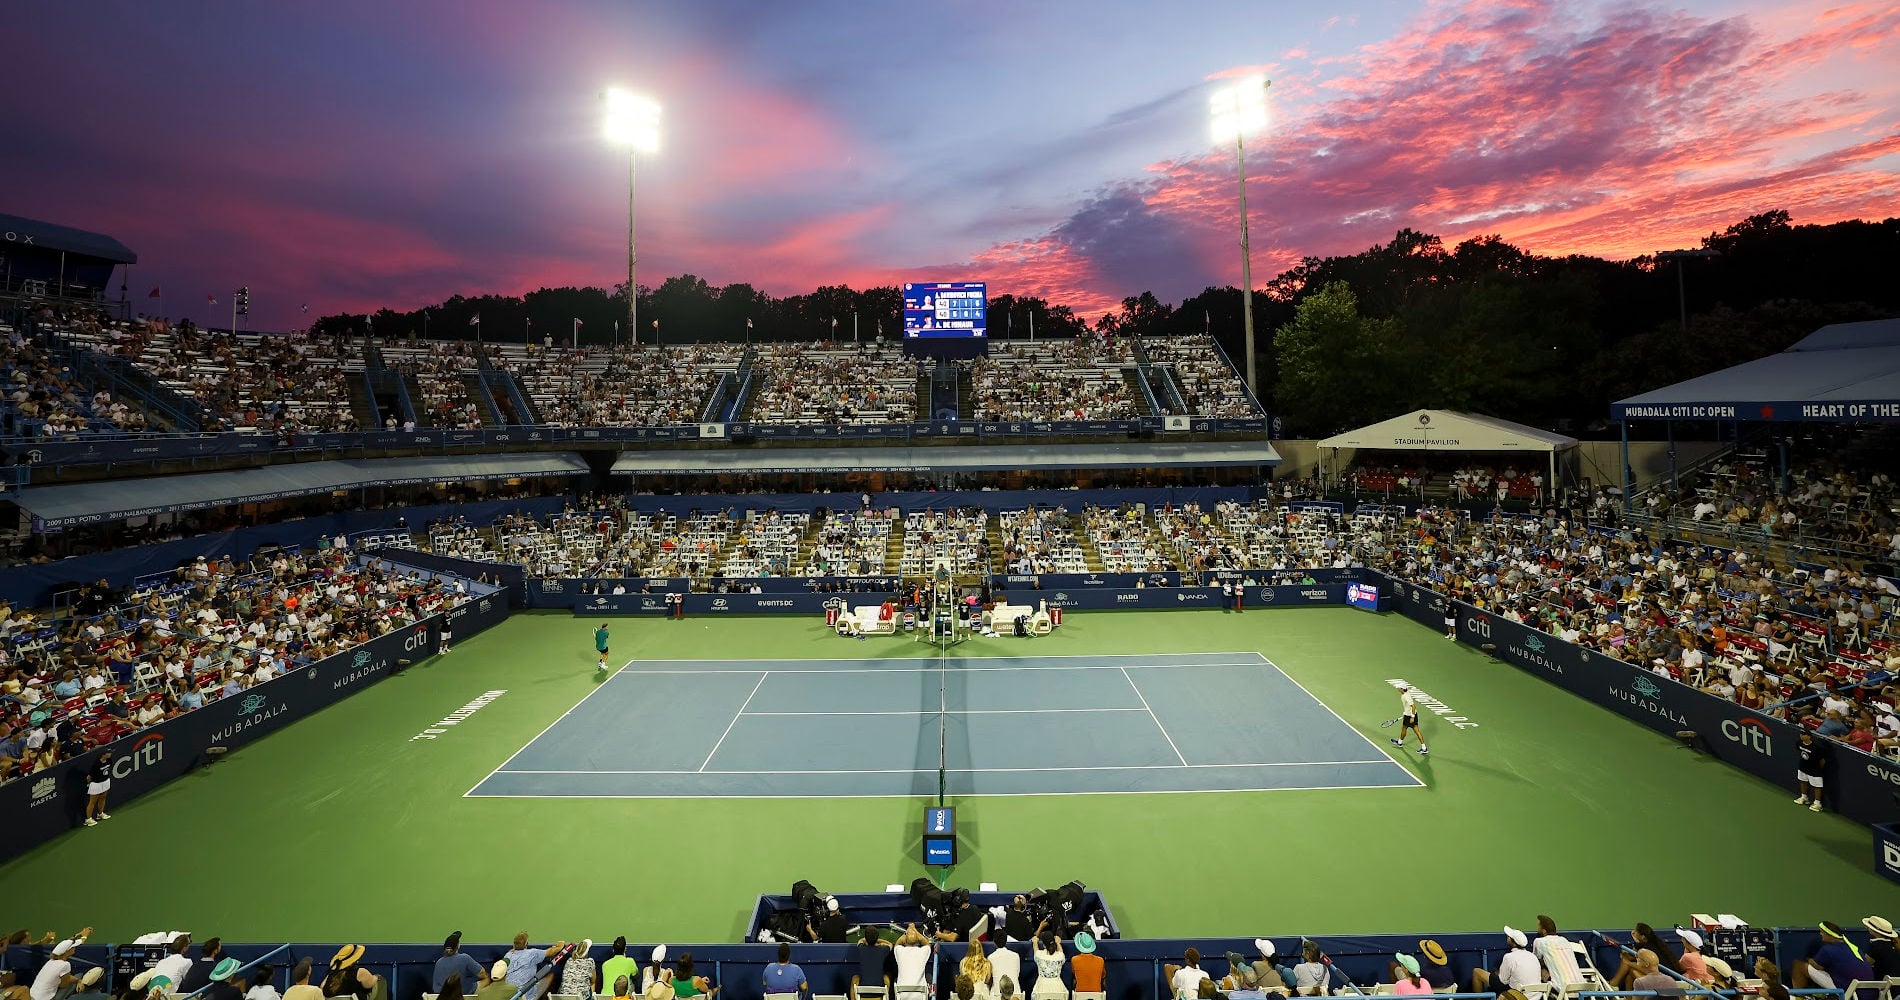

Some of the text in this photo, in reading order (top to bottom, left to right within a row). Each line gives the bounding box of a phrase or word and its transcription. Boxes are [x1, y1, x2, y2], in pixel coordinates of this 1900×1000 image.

[1626, 406, 1735, 417] MUBADALA CITI DC OPEN
[1803, 404, 1900, 417] HEART OF THE
[46, 519, 62, 527] 2009
[79, 514, 101, 523] POTRO
[124, 508, 162, 517] NALBANDIAN
[1217, 571, 1242, 579] Wilson
[1300, 589, 1327, 597] verizon
[1468, 618, 1491, 638] citi
[405, 629, 427, 652] citi
[1509, 644, 1563, 675] MUBADALA
[333, 659, 387, 690] MUBADALA
[1609, 685, 1688, 727] MUBADALA
[211, 703, 288, 744] MUBADALA
[1721, 719, 1772, 757] citi
[112, 738, 164, 780] citi
[30, 791, 58, 808] KASTLE
